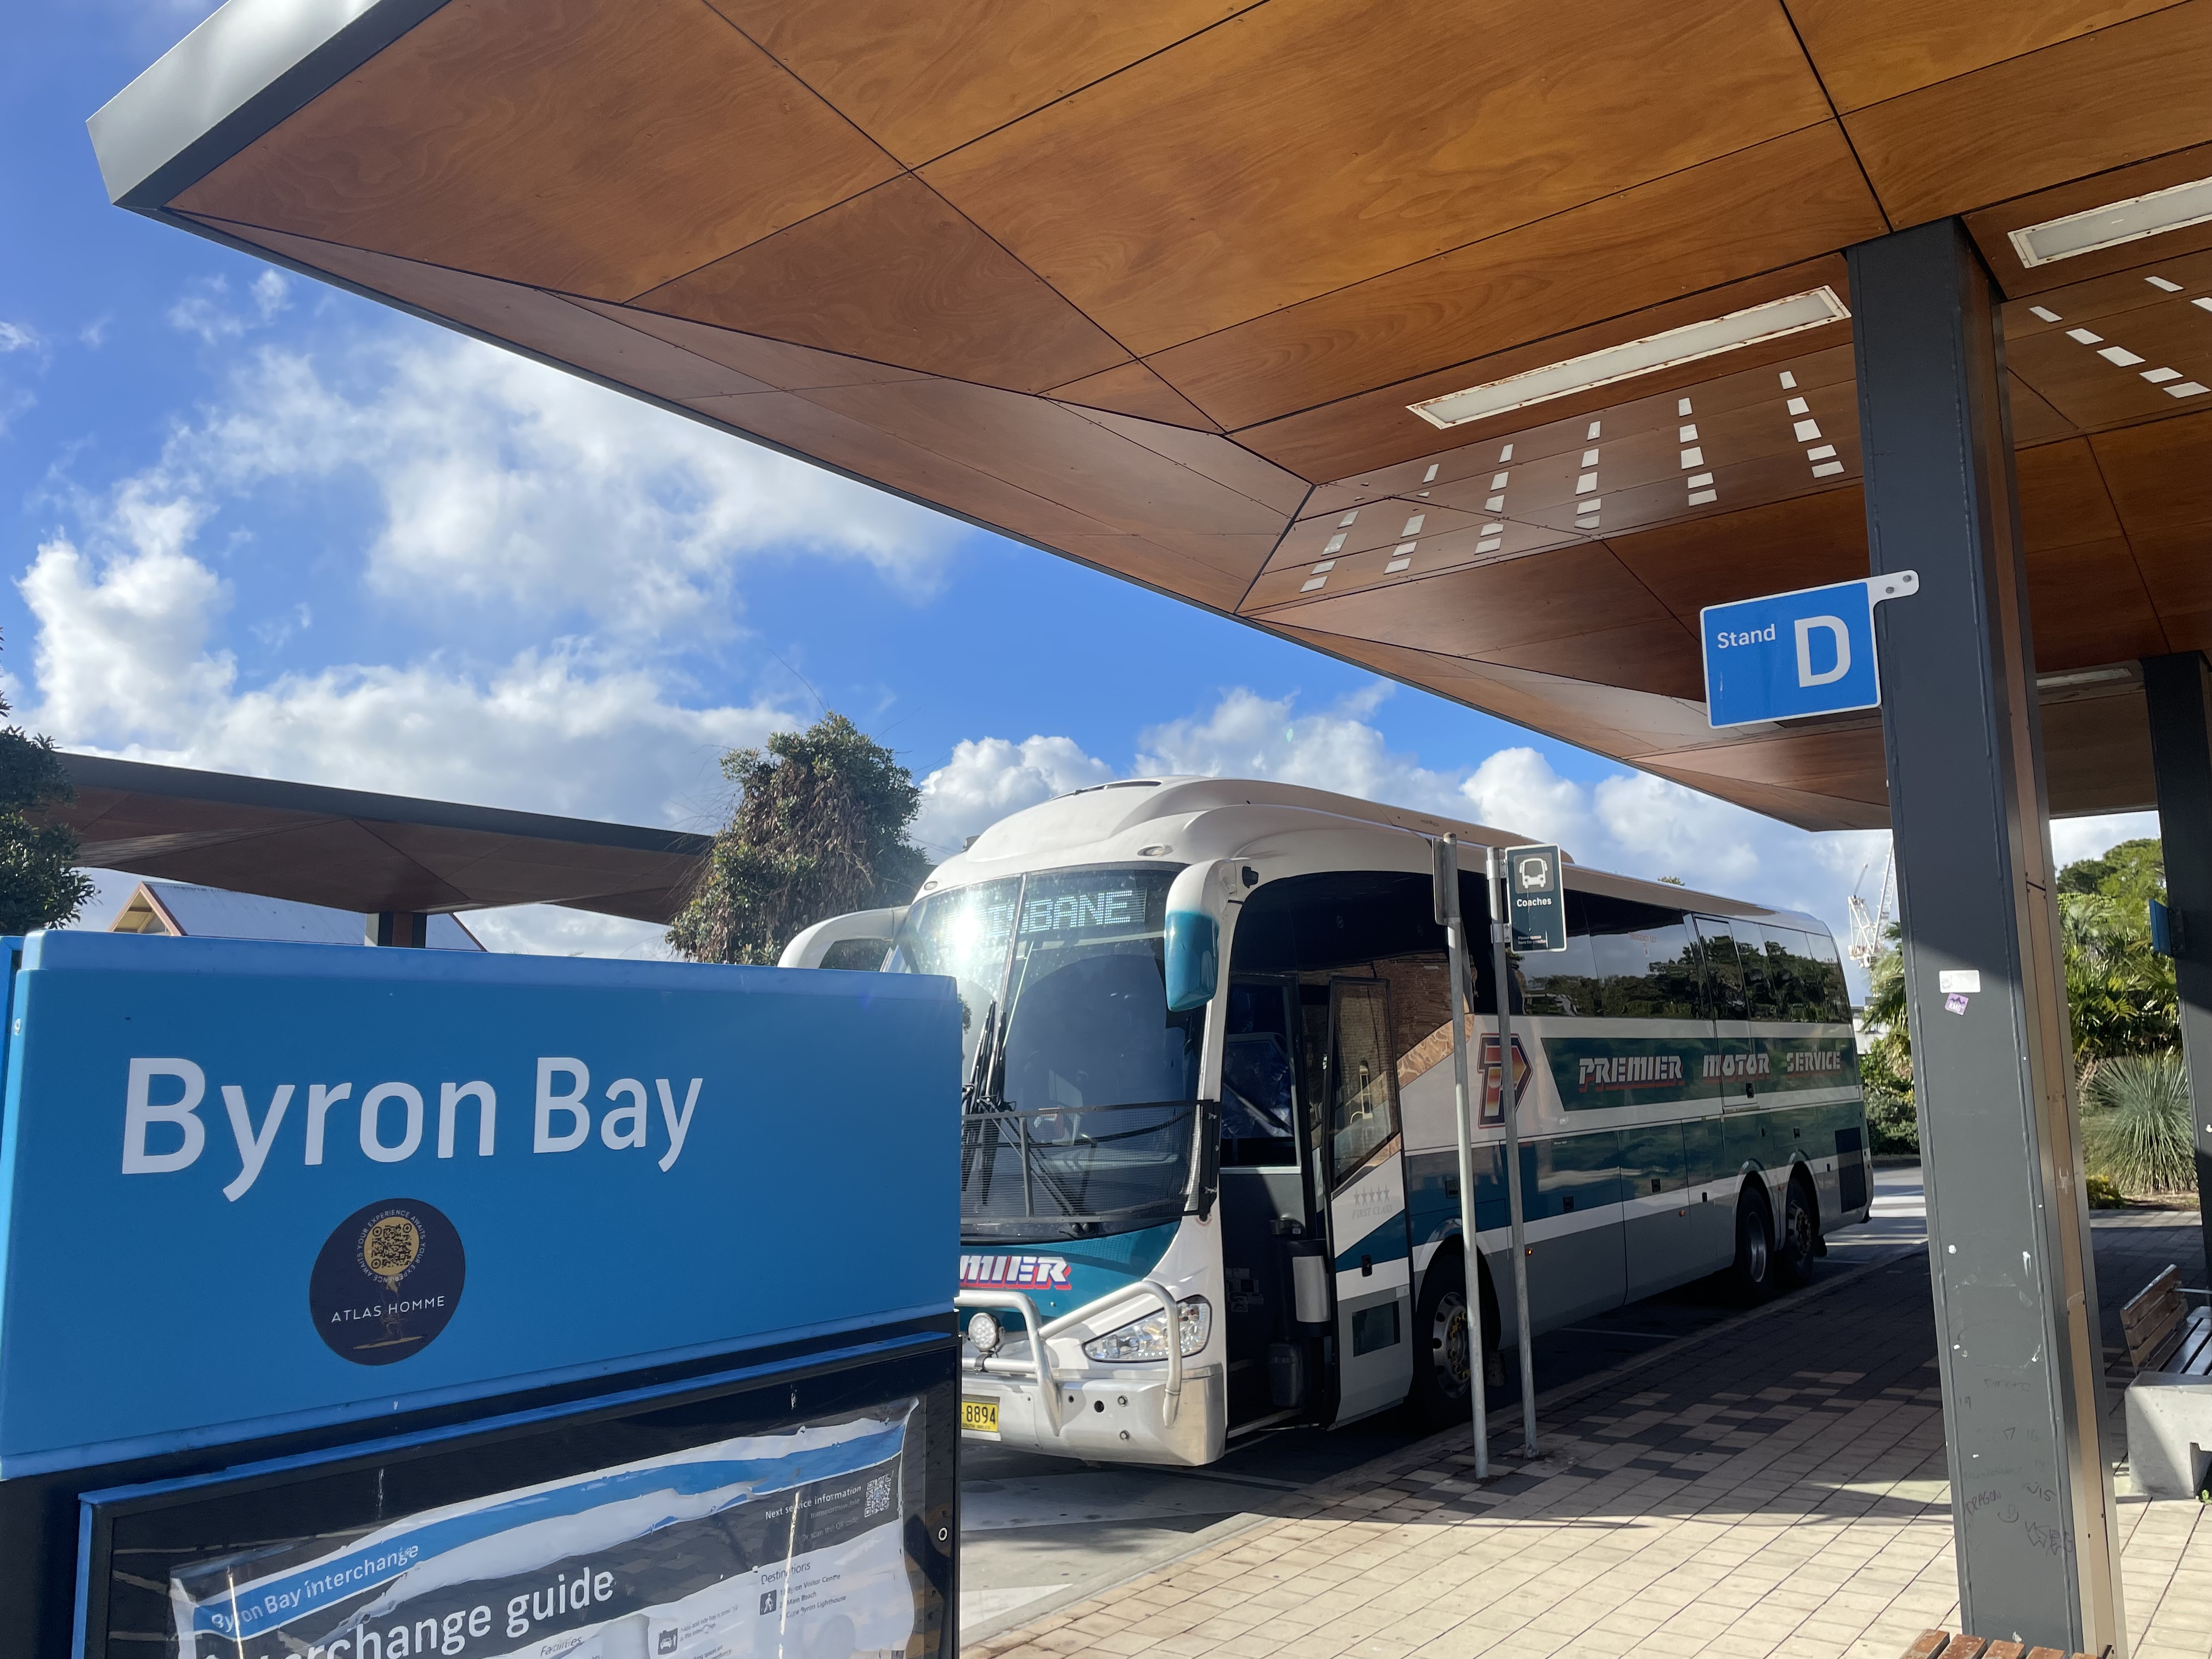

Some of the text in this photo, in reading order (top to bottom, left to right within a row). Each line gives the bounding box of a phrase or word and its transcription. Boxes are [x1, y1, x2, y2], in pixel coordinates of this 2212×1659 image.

[1717, 623, 1776, 649] Stand
[1794, 615, 1852, 688] D
[973, 889, 1133, 937] ISBANE
[1516, 897, 1552, 907] Coaches
[1578, 1051, 1842, 1090] PREMIER MOTOR SERVICE
[121, 1057, 703, 1202] Byron Bay
[368, 1209, 410, 1228] EXPERIENCE
[1352, 1204, 1393, 1219] FIRST CLASS
[357, 1227, 369, 1250] YOUR
[410, 1215, 426, 1240] AWAITS
[414, 1243, 426, 1264] YOUR
[960, 1255, 1071, 1289] MIER
[331, 1295, 445, 1323] ATLAS HOMME
[966, 1405, 996, 1425] 8894
[765, 1485, 862, 1520] Next sevice information
[761, 1562, 811, 1585] Destintions
[803, 1579, 821, 1589] Visitor
[211, 1605, 263, 1633] Byon
[264, 1589, 301, 1615] Bay
[787, 1596, 800, 1606] Main
[801, 1591, 817, 1601] Beach
[817, 1595, 847, 1608] Lighthouse
[203, 1566, 617, 1659] rchange guide
